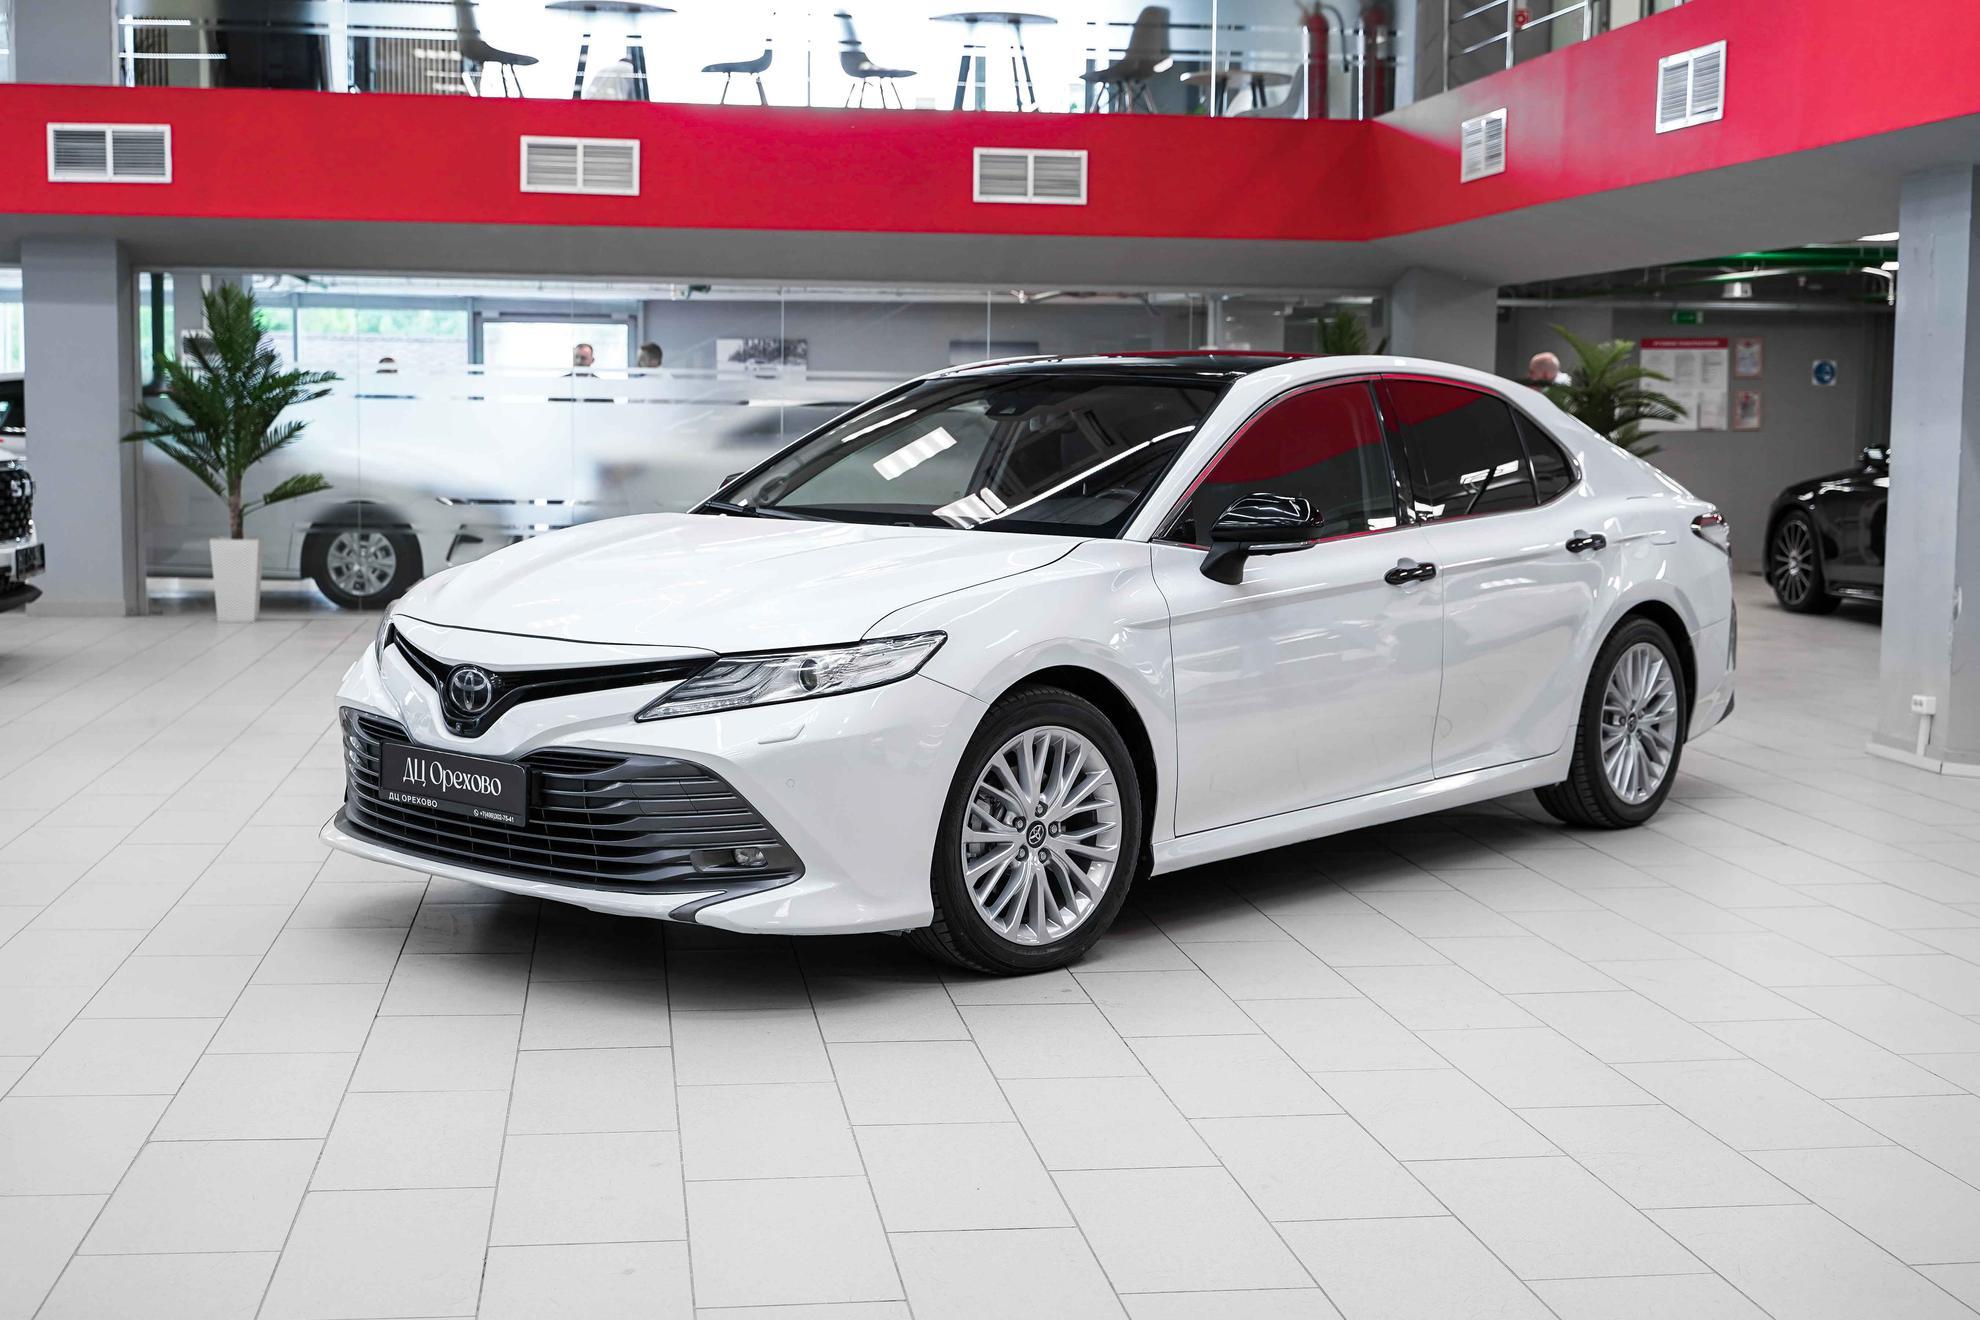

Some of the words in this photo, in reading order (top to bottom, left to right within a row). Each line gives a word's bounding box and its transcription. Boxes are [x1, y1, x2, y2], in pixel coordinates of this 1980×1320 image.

[403, 757, 426, 787] ДЦ
[430, 762, 502, 796] Орехово
[389, 792, 400, 801] ДЦ
[401, 795, 438, 808] ОРЕХОВО
